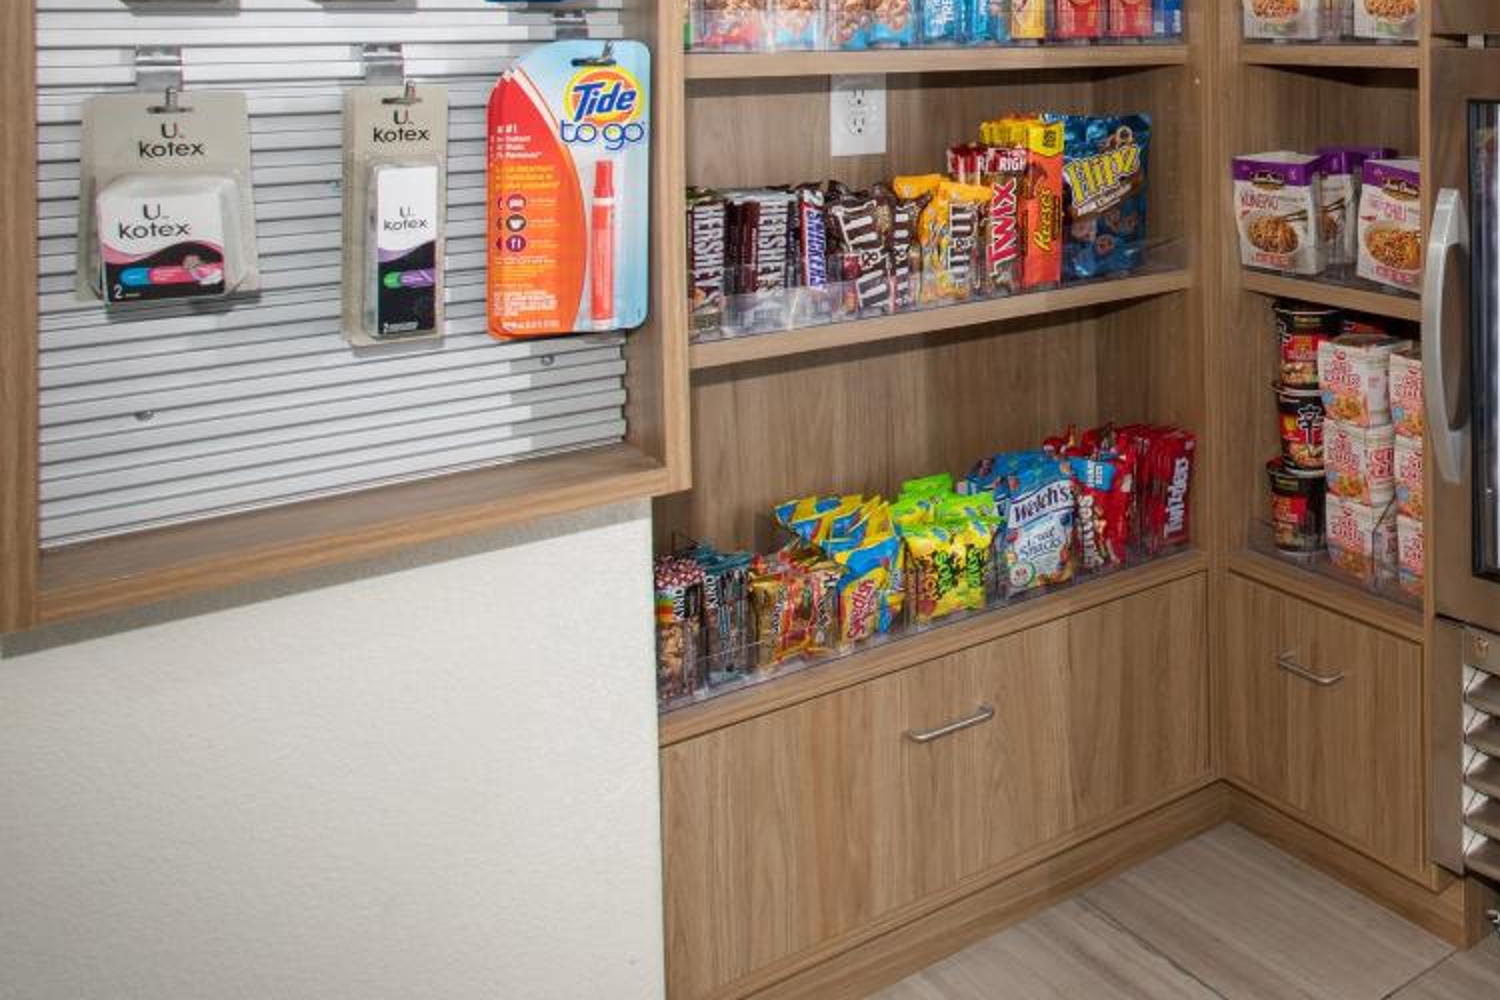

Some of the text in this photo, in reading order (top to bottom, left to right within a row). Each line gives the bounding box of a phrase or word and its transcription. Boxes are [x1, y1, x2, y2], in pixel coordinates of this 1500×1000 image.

[573, 80, 637, 122] Tide
[560, 119, 645, 151] to go
[988, 176, 1017, 269] TWIX
[1013, 481, 1073, 524] Welch's
[672, 586, 687, 622] KIND
[703, 574, 719, 610] KIND
